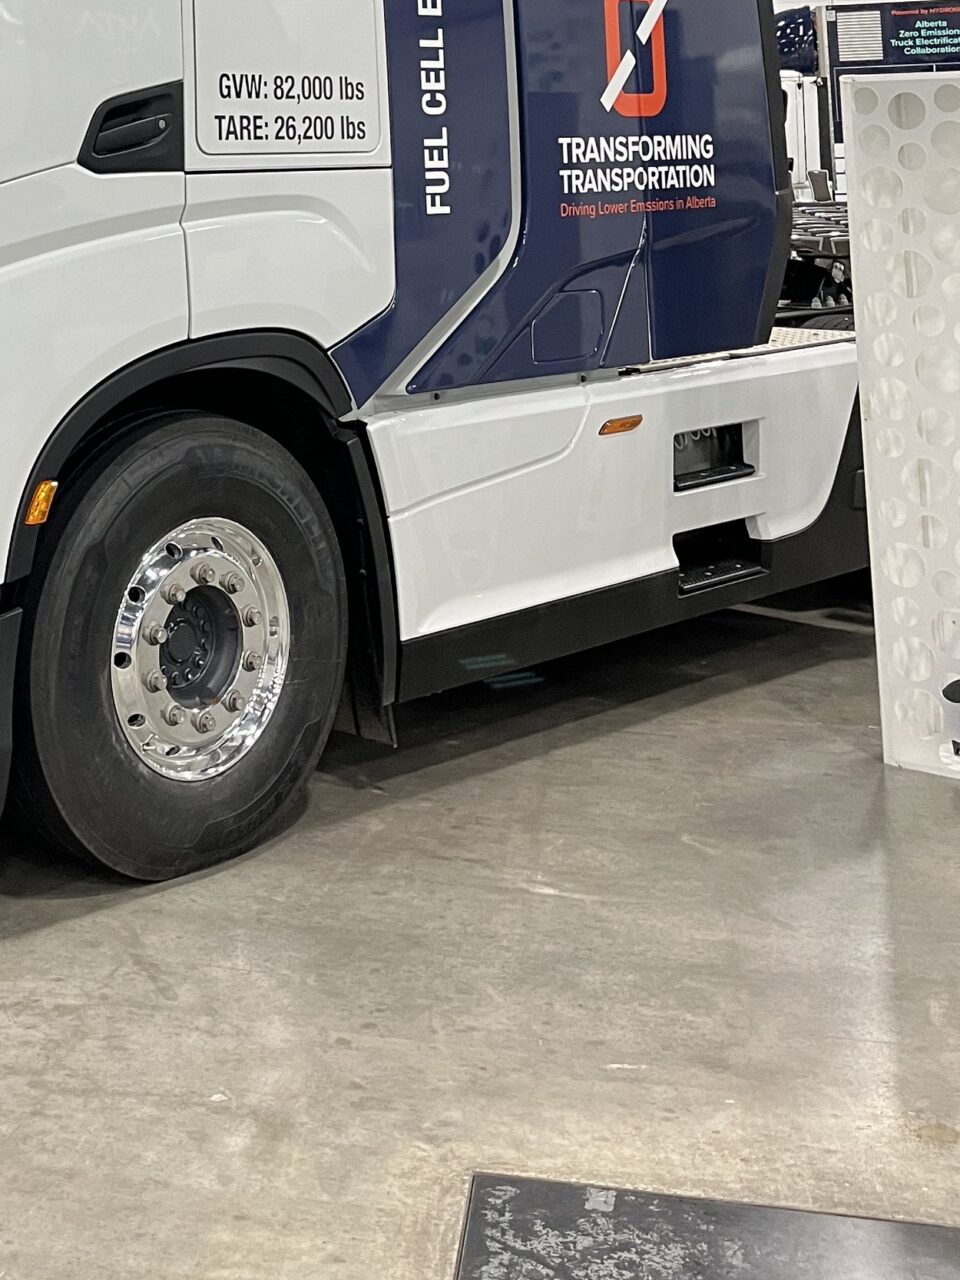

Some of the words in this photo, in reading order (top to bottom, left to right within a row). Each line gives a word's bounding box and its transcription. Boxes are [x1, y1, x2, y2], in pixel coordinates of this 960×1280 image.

[914, 20, 947, 28] Alberta
[890, 39, 914, 47] Truck
[418, 27, 447, 116] CELL
[218, 72, 269, 99] GVW:
[273, 75, 334, 104] 82,000
[339, 76, 365, 100] lbs
[214, 115, 269, 141] TARE:
[274, 115, 335, 145] 26,200
[340, 115, 366, 140] lbs
[557, 133, 715, 164] TRANSFORMING
[423, 126, 451, 215] FUEL
[559, 164, 716, 194] TRANSPORTATION
[560, 202, 597, 219] Driving
[598, 200, 628, 216] Lower
[630, 198, 675, 213] Emssions
[676, 196, 685, 209] in
[685, 195, 717, 209] Alberta
